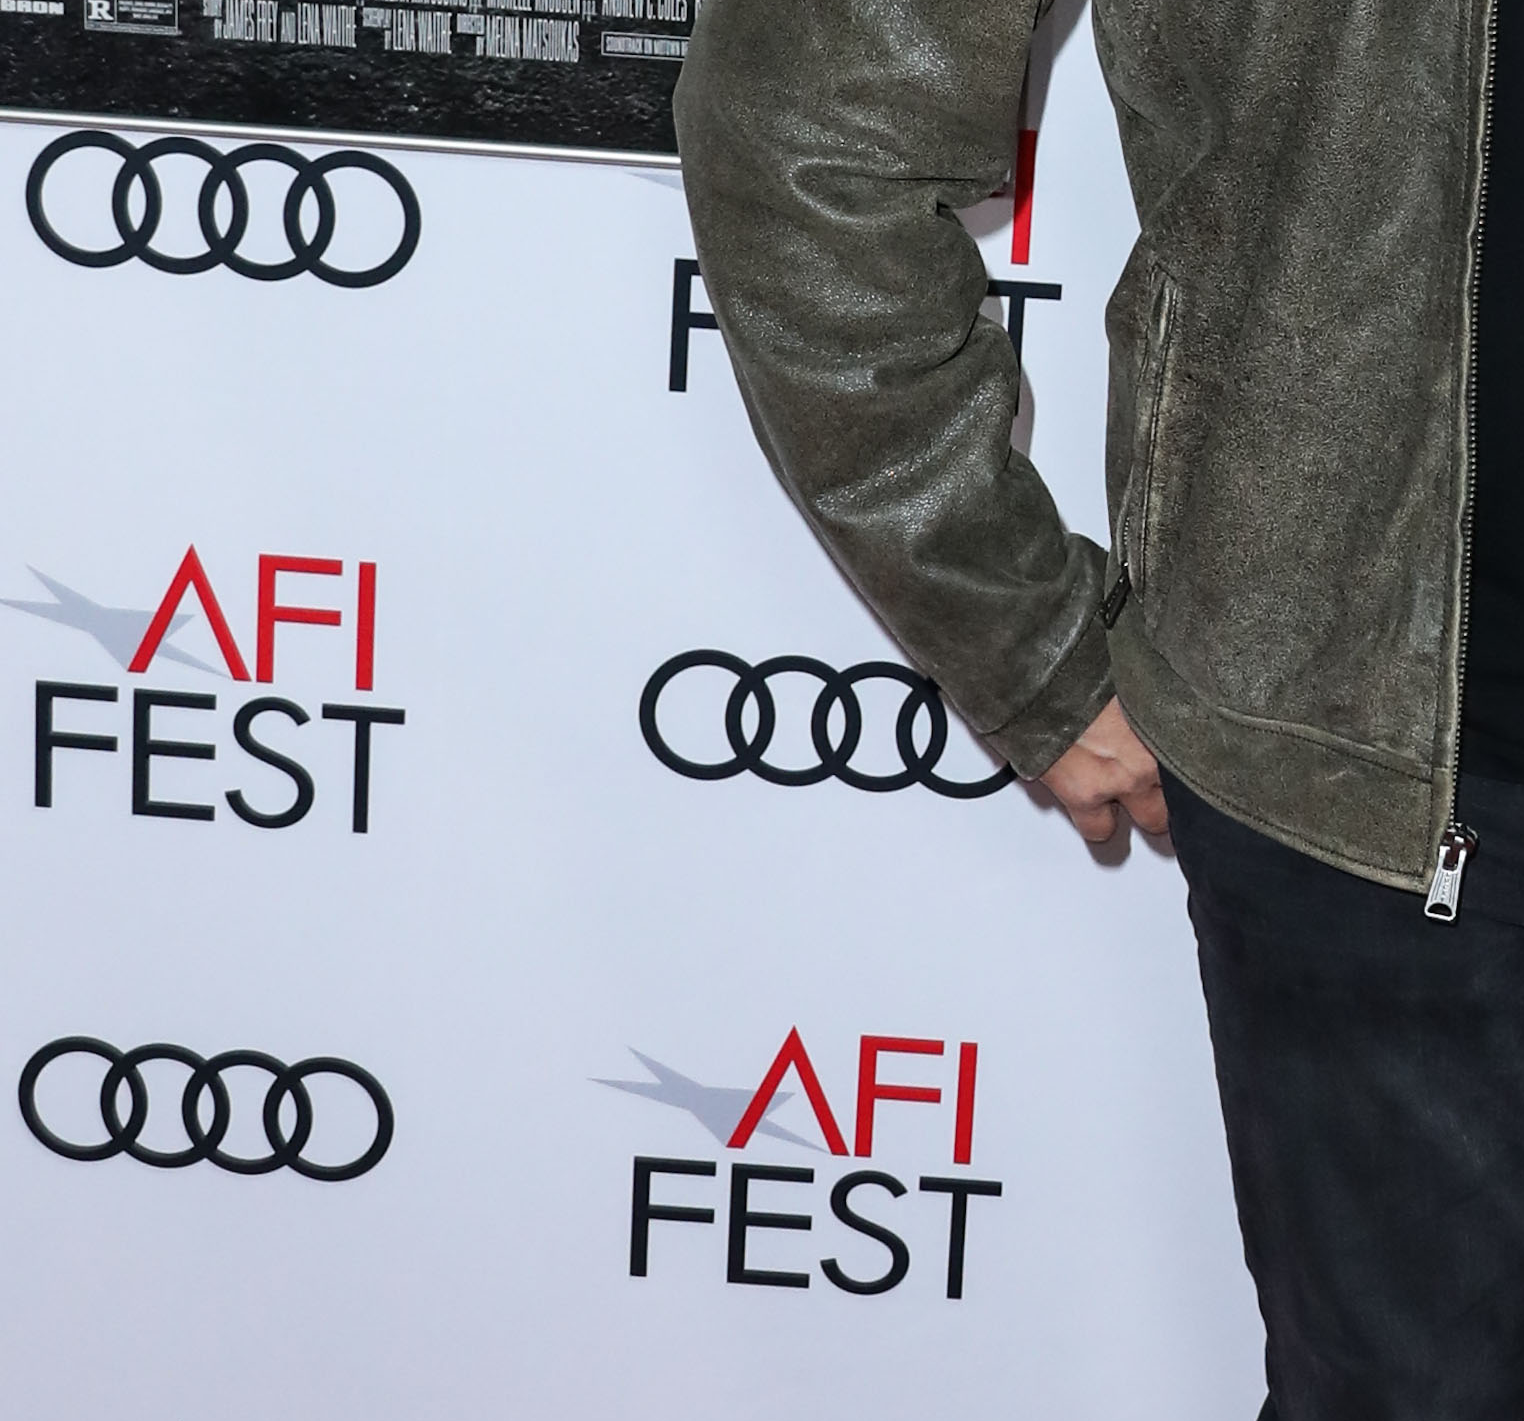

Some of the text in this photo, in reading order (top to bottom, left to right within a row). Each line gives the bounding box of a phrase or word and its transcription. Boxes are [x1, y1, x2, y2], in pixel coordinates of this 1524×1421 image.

[87, 0, 114, 21] R
[257, 0, 278, 42] FREY
[128, 544, 378, 692] AFI
[33, 680, 406, 835] FEST
[726, 1026, 979, 1166] AFI
[628, 1155, 1003, 1301] FEST
